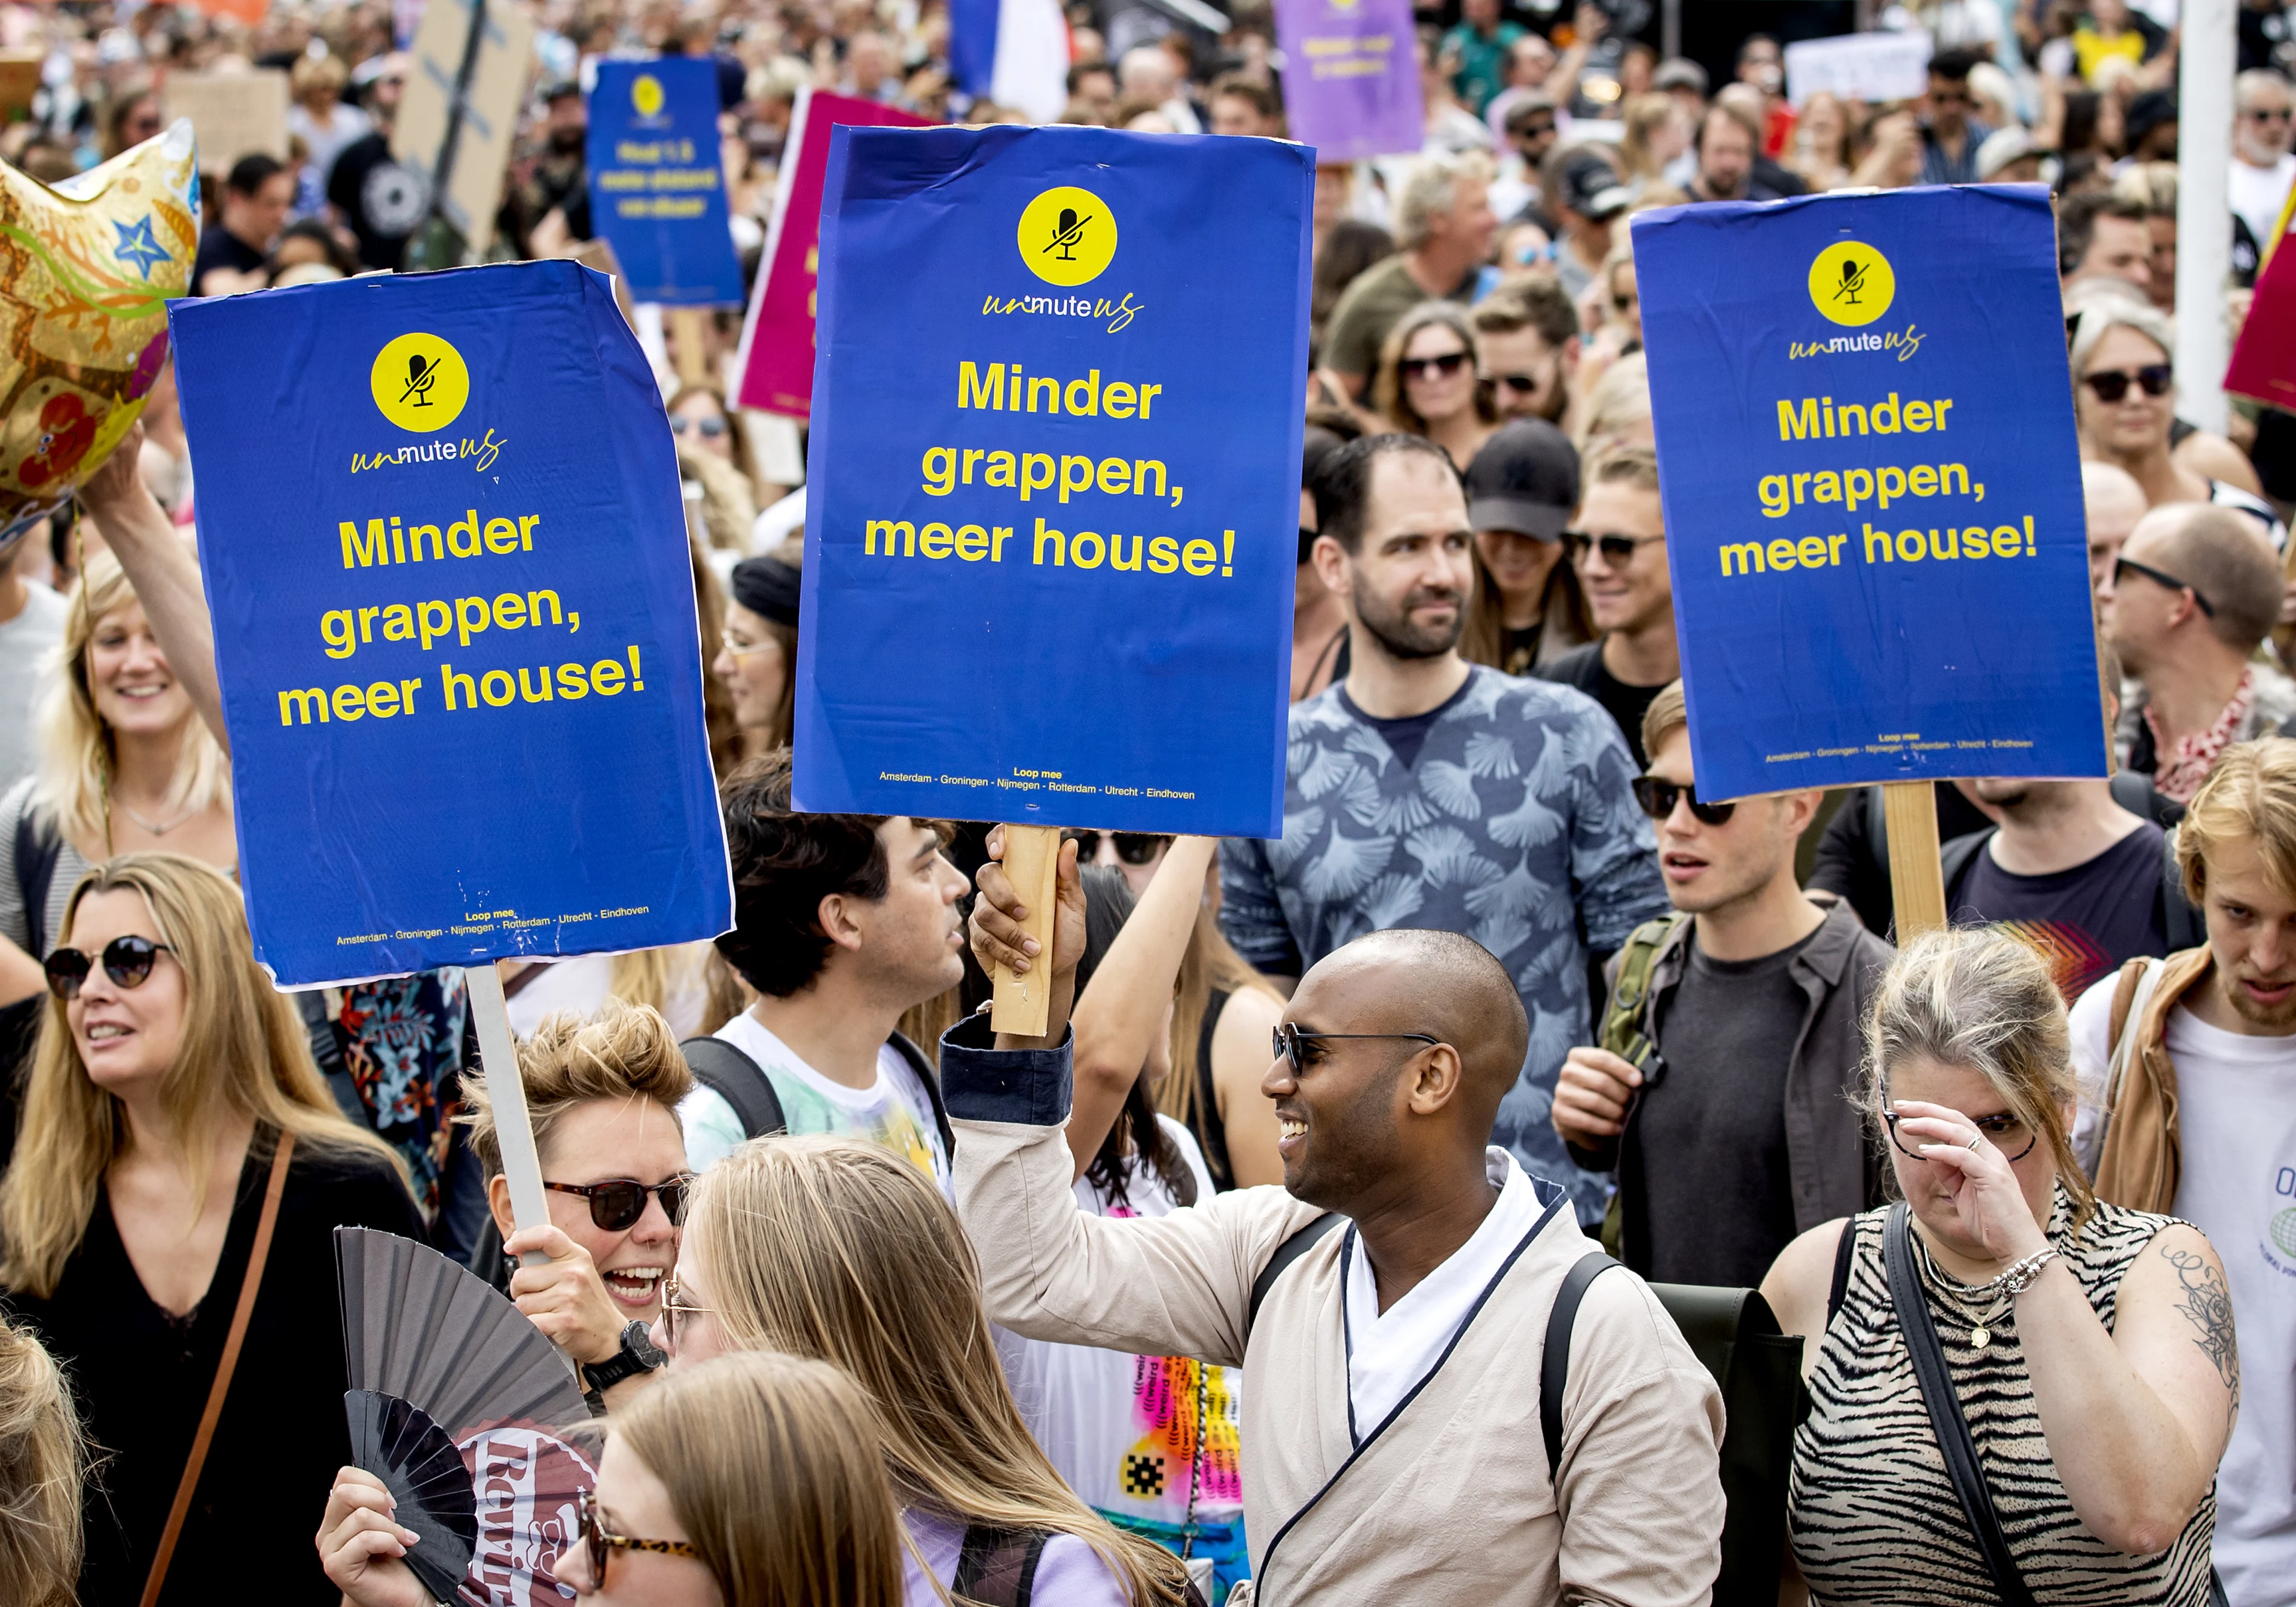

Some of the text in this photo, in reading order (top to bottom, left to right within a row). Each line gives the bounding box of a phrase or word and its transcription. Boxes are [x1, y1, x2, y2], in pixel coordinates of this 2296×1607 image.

[957, 360, 1162, 420] Minder
[1776, 392, 1953, 441] Minder
[921, 447, 1183, 508] grappen,
[1758, 463, 1985, 518] grappen,
[338, 509, 540, 569] Minder
[865, 517, 1235, 578] meer house!
[1719, 515, 2037, 577] meer house!
[320, 589, 580, 659] grappen,
[277, 644, 645, 726] meer house!
[1766, 751, 1810, 763] Amsterdam
[1817, 747, 1859, 757] Groningen
[1866, 745, 1903, 753] Nijmegen
[1910, 742, 1950, 750] Rotterdam
[1992, 740, 2033, 748] Eindhoven
[1879, 734, 1901, 743] Loop
[880, 771, 932, 783] Amsterdam
[941, 774, 988, 788] Groningen
[997, 778, 1040, 791] Nijmegen
[1049, 781, 1096, 793] Rotterdam
[1105, 786, 1138, 796] Utrecht
[1146, 788, 1195, 800] Eindhoven
[1013, 767, 1062, 780] Loop mee
[337, 933, 388, 945] Amsterdam
[395, 928, 442, 940] Groningen
[451, 922, 494, 936] Nijmegen
[502, 916, 551, 930] Rotterdam
[559, 911, 593, 924] Utrecht
[600, 905, 649, 919] Eindhoven
[465, 909, 514, 922] Loop mee
[1134, 1355, 1146, 1395] (((weir
